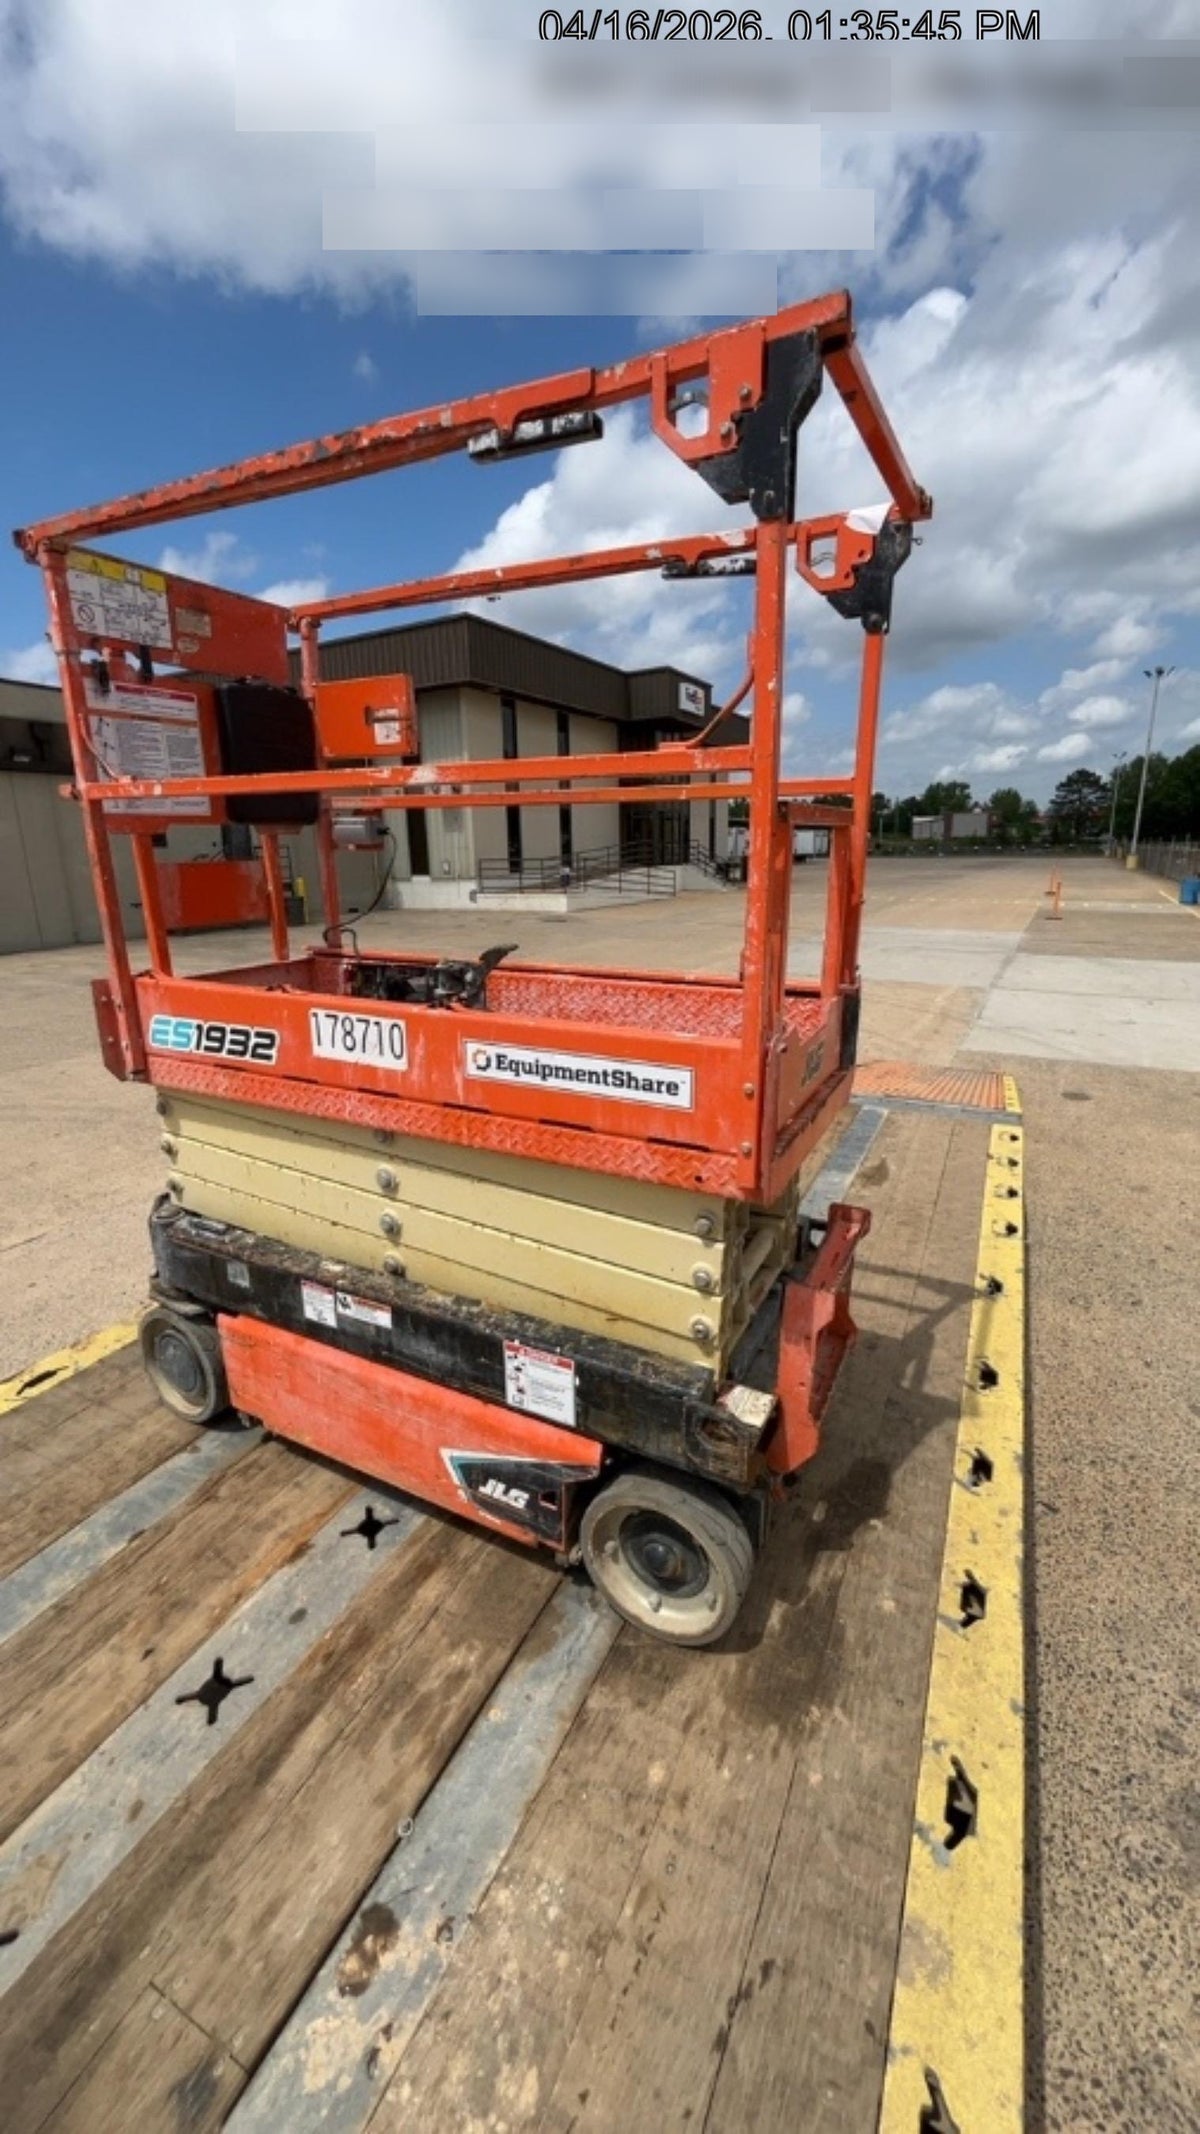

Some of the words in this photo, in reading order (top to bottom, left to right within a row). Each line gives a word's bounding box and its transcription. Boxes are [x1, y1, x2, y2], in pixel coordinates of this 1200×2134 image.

[151, 1018, 276, 1061] ES1932
[312, 1012, 404, 1060] 178710
[495, 1053, 680, 1096] EquipmentShare
[478, 1478, 530, 1509] JLG
